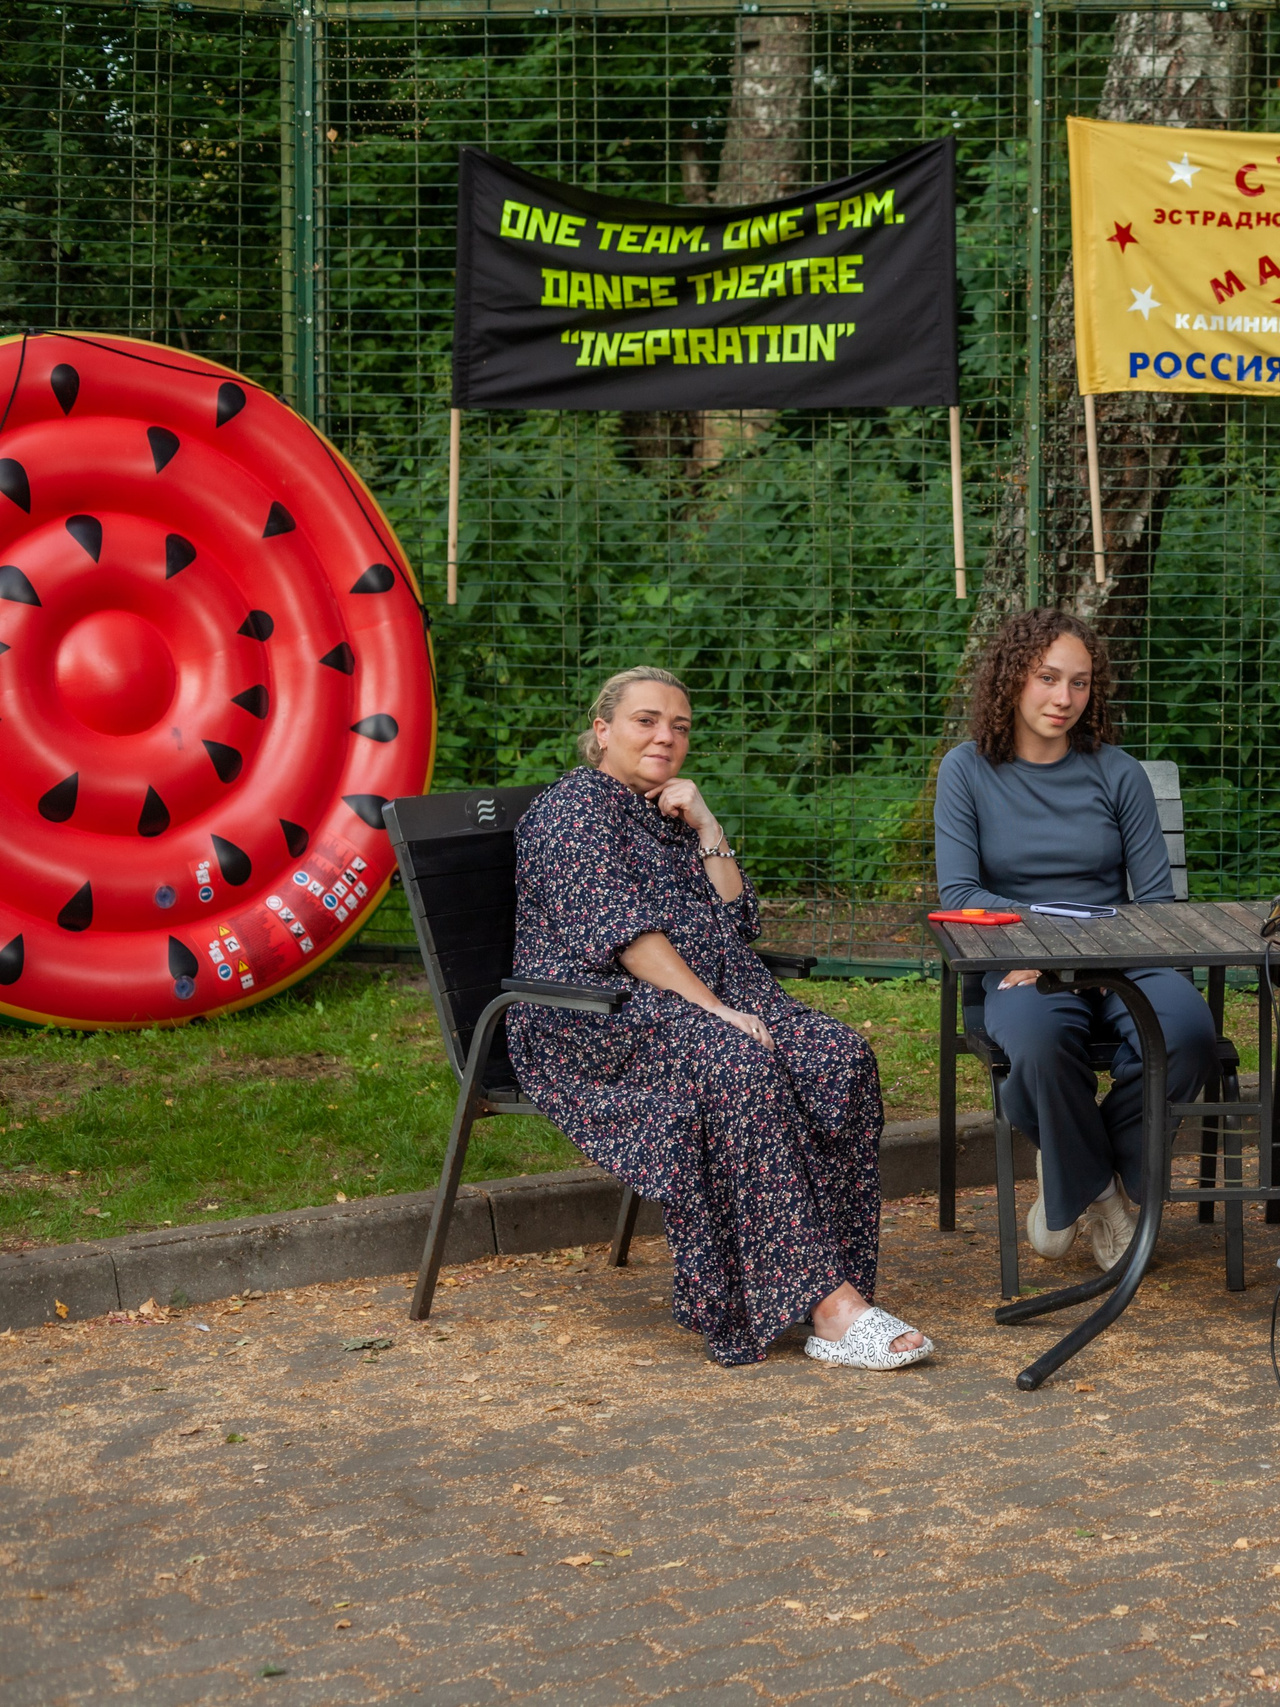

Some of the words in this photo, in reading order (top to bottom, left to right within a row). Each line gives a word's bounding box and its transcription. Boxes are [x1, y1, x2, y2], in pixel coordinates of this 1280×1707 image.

[500, 199, 587, 249] ONE
[597, 221, 711, 254] TEAM.
[722, 207, 805, 251] ONE
[816, 188, 906, 236] FAM.
[540, 267, 678, 310] DANCE
[687, 253, 865, 304] THEATRE
